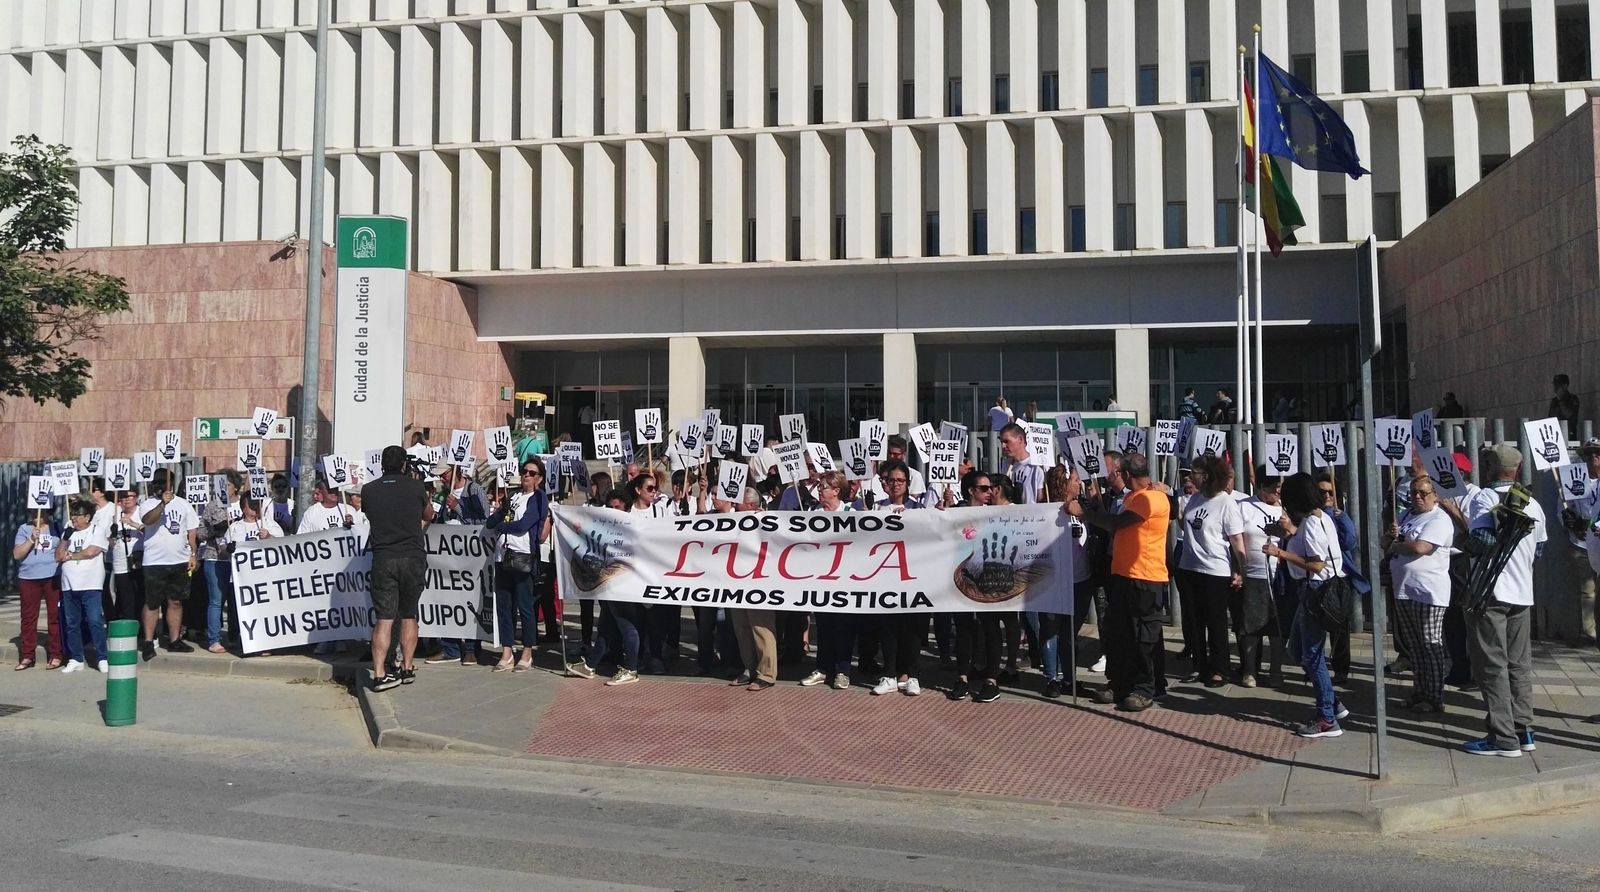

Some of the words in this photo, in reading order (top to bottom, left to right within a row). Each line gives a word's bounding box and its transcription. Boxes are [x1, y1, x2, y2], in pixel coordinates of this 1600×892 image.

[355, 276, 369, 323] Justicia
[354, 327, 368, 338] la
[354, 341, 369, 356] de
[353, 360, 368, 403] Ciudad
[1160, 431, 1176, 439] FUE
[597, 443, 620, 456] SOLA
[932, 442, 945, 450] NO
[947, 442, 959, 450] SE
[934, 454, 954, 462] FUE
[931, 466, 956, 480] SOLA
[188, 493, 208, 504] SOLA
[251, 487, 268, 498] SOLA
[674, 515, 779, 532] TODOS
[788, 514, 905, 532] SOMOS
[1026, 539, 1038, 547] SIN
[234, 539, 332, 572] PEDIMOS
[663, 540, 917, 581] LUCIA
[239, 582, 270, 606] DE
[272, 569, 372, 601] TELÉFONOS
[424, 568, 475, 591] VILES
[642, 585, 785, 606] EXIGIMOS
[793, 590, 934, 609] JUSTICIA
[242, 618, 257, 641] Y
[264, 613, 296, 637] UN
[417, 603, 467, 627] UIPO
